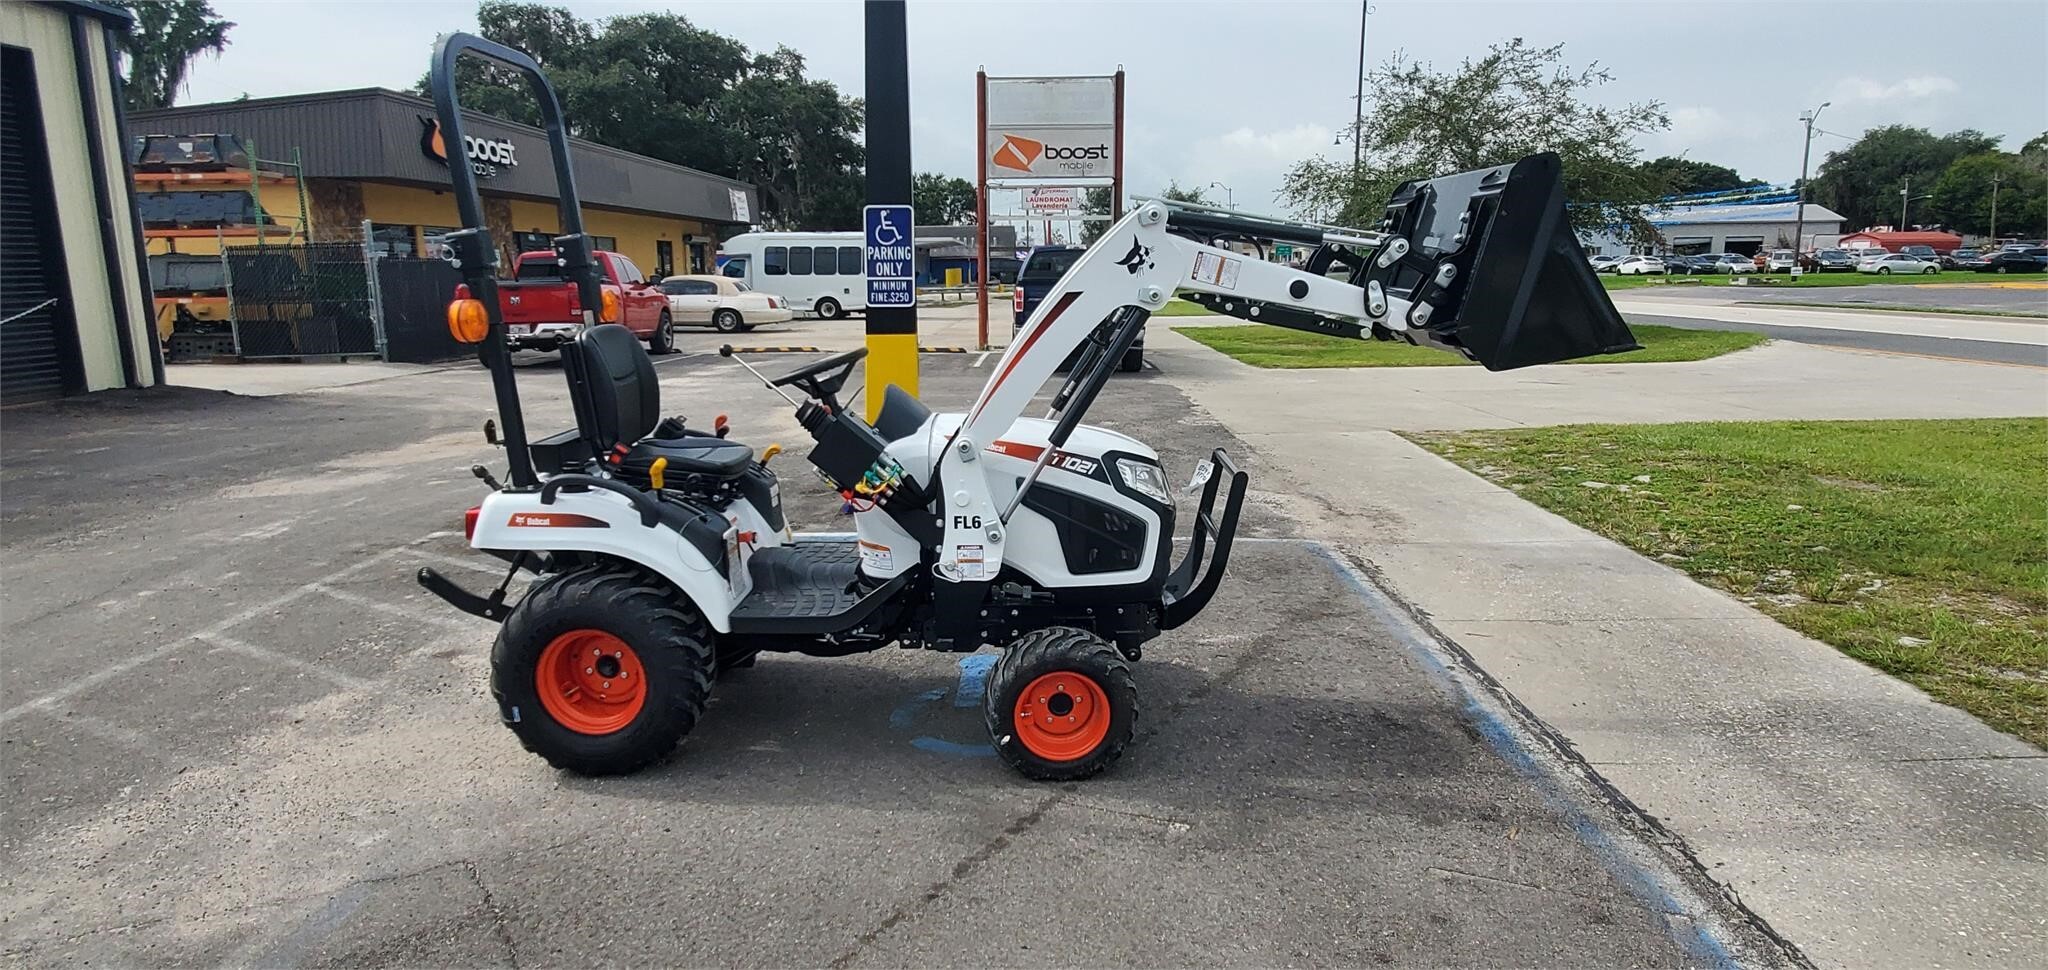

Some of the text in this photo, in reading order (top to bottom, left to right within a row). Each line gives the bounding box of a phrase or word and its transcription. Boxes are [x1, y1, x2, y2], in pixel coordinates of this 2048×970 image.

[1045, 144, 1108, 159] boost
[1060, 162, 1094, 170] mobile
[868, 246, 911, 260] PARKING
[876, 262, 903, 276] ONLY
[873, 281, 907, 291] MINIMUM
[1043, 452, 1098, 475] T1021
[527, 517, 550, 525] Bobcat
[954, 516, 981, 529] FL6
